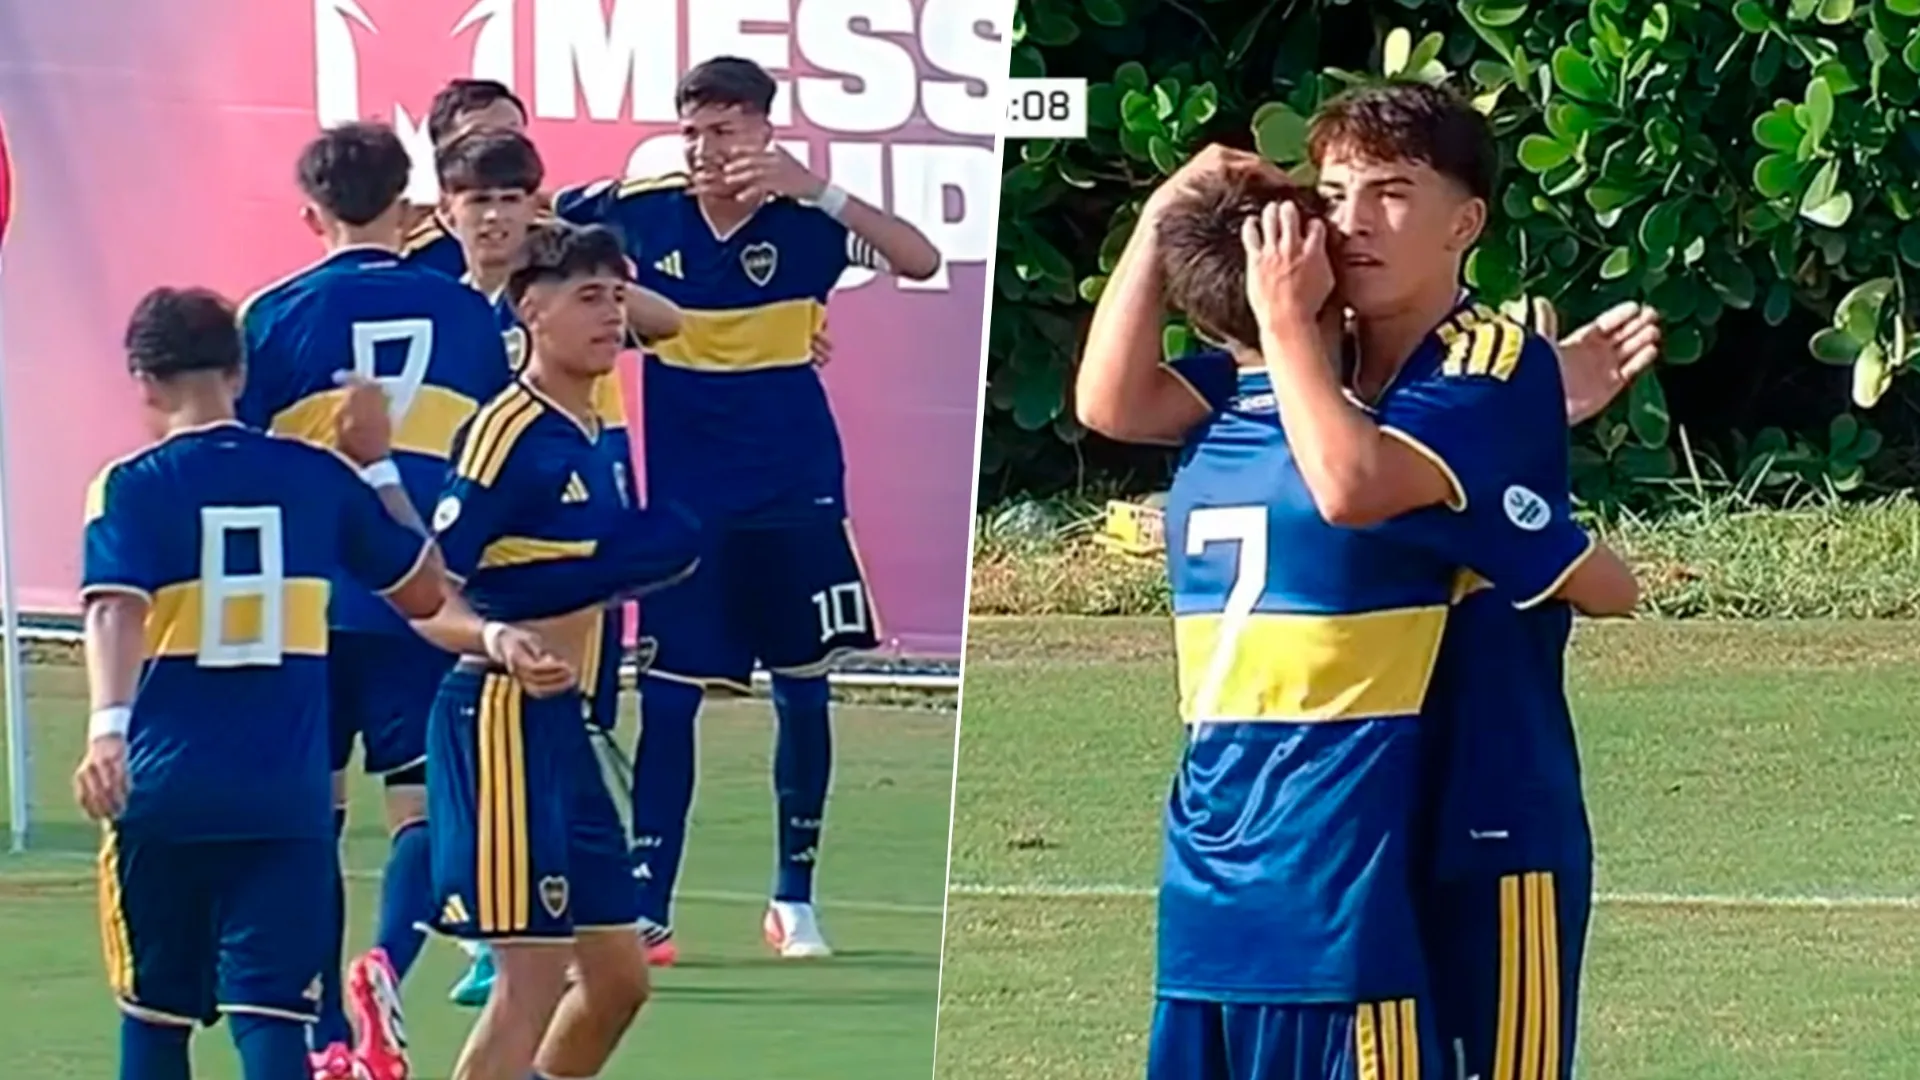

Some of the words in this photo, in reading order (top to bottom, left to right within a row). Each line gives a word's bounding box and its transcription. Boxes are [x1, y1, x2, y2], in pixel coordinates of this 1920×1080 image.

[352, 319, 433, 430] 9
[197, 506, 284, 667] 8
[811, 581, 866, 642] 10
[1185, 505, 1268, 738] 7
